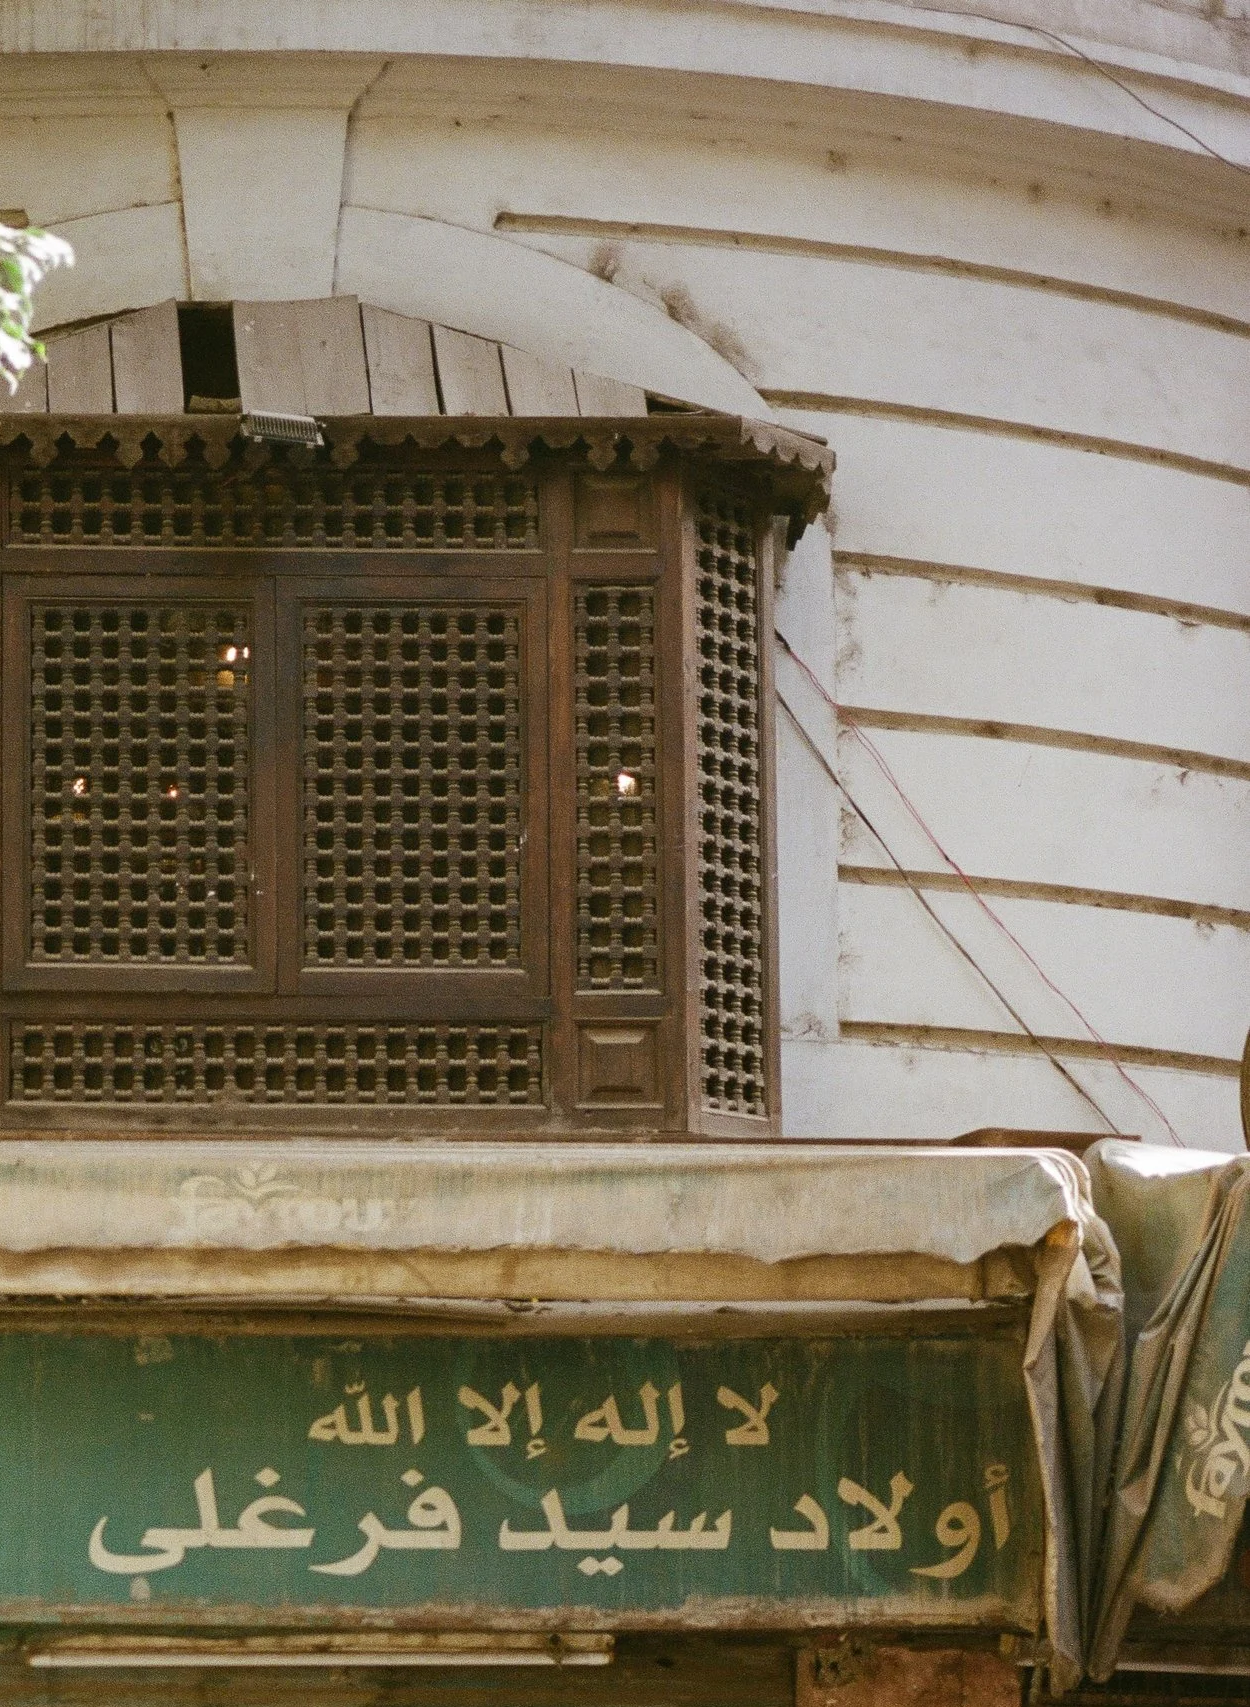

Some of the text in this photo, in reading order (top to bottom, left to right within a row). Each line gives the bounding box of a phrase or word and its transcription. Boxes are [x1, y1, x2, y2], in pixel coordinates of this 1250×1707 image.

[307, 1379, 780, 1460] لا إله إلا الله
[498, 1487, 733, 1577] سيد
[770, 1464, 1011, 1580] أولاد
